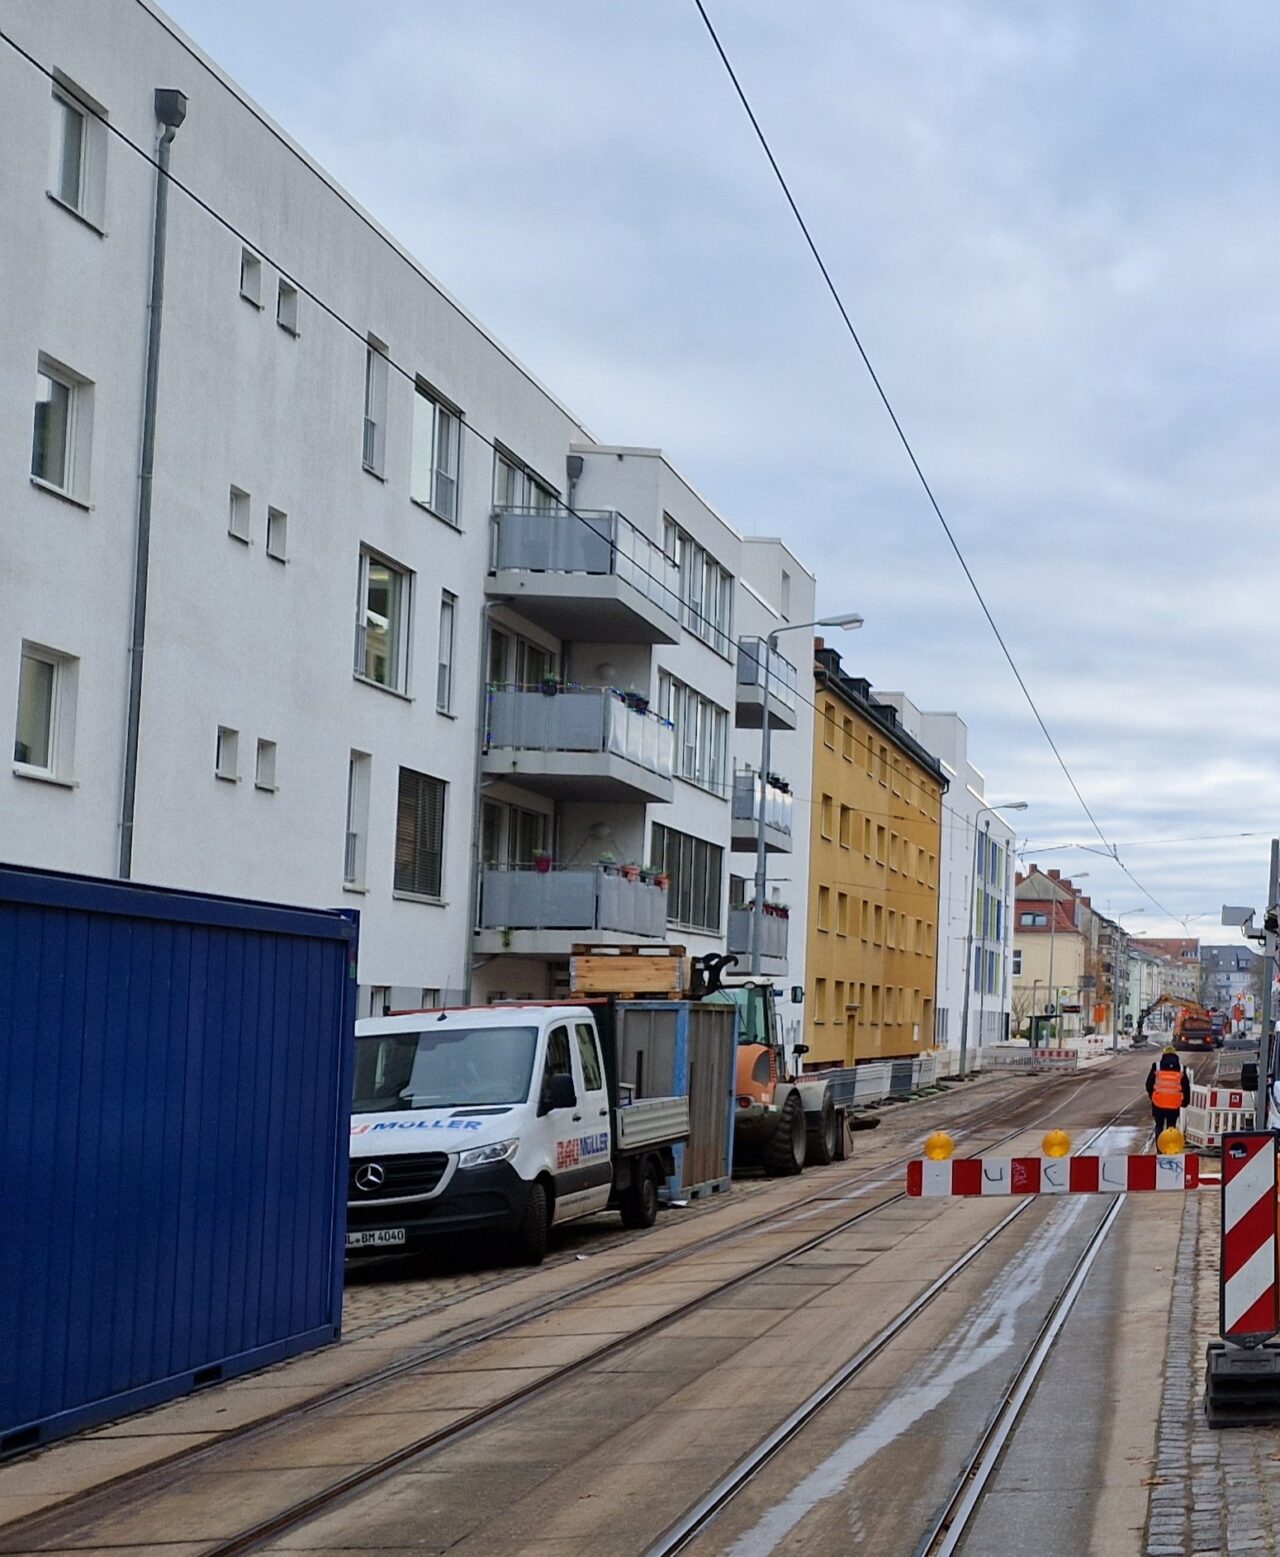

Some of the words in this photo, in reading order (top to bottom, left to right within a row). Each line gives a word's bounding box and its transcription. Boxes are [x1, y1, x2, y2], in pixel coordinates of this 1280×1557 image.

[556, 1138, 579, 1169] BAU
[362, 1232, 376, 1244] BM
[378, 1230, 404, 1241] 4040
